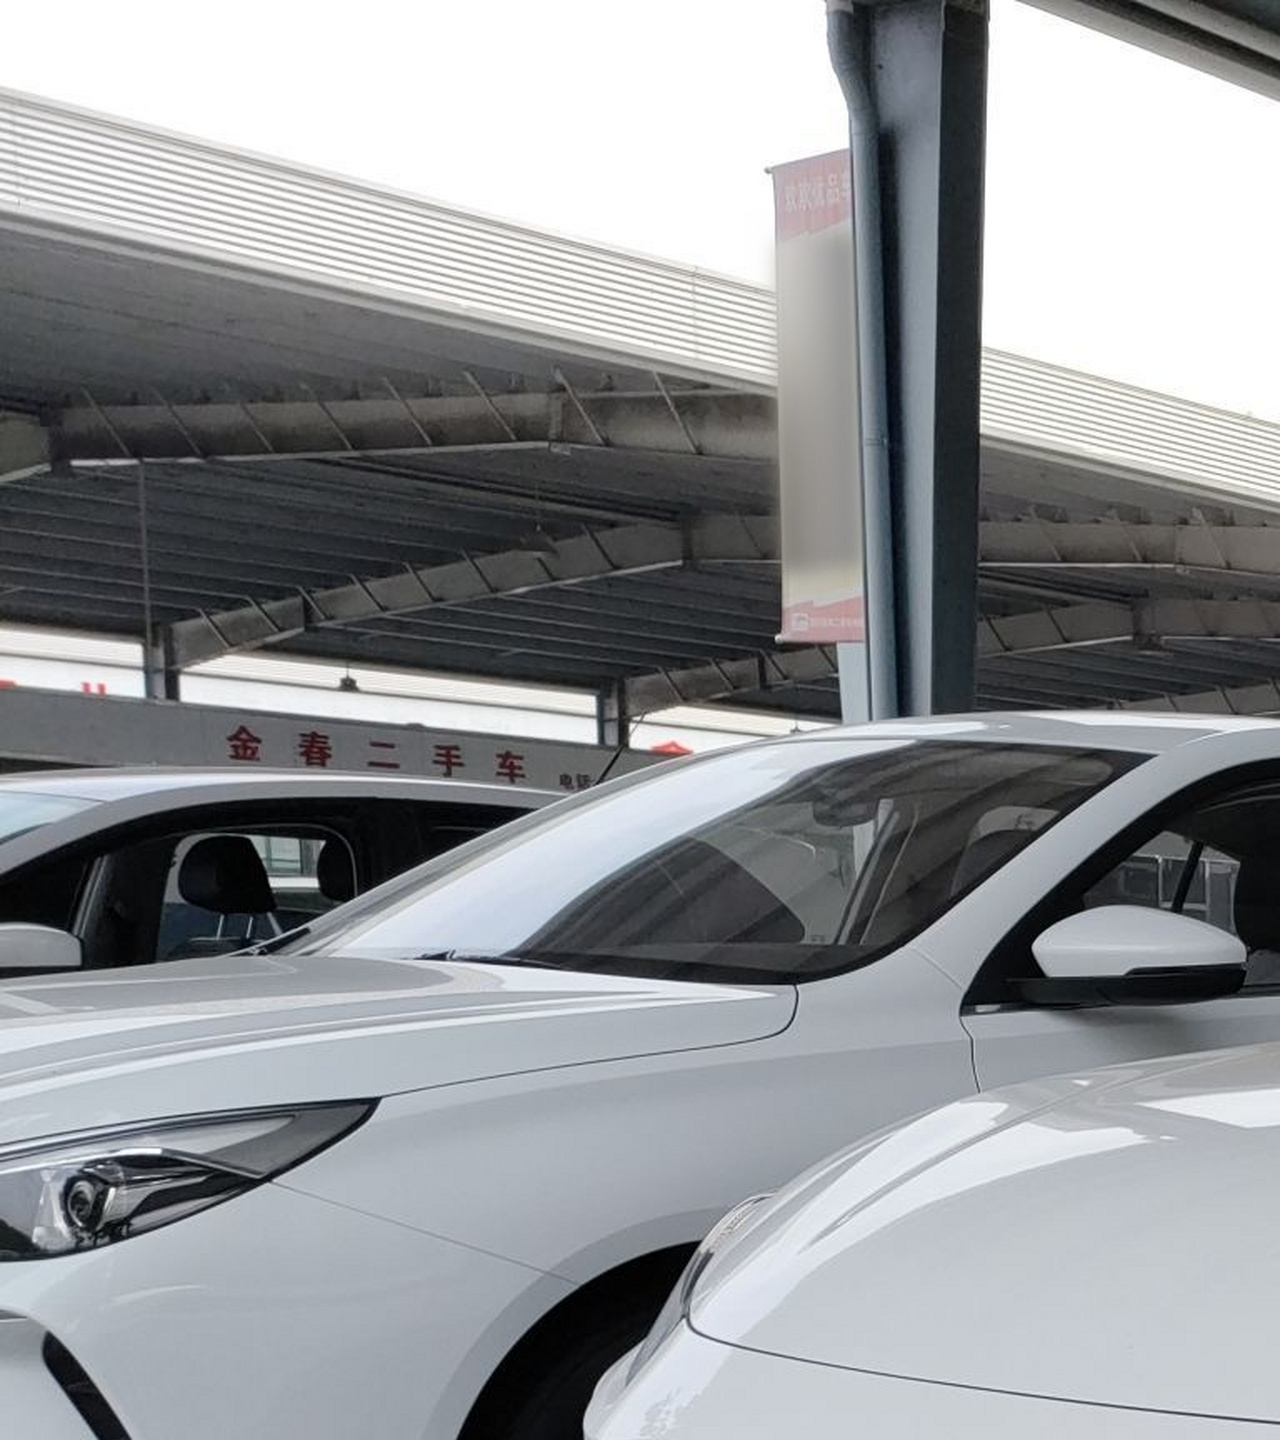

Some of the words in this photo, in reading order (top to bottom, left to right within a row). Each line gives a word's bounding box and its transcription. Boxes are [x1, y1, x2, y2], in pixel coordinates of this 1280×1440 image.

[226, 724, 526, 784] 金春二手车
